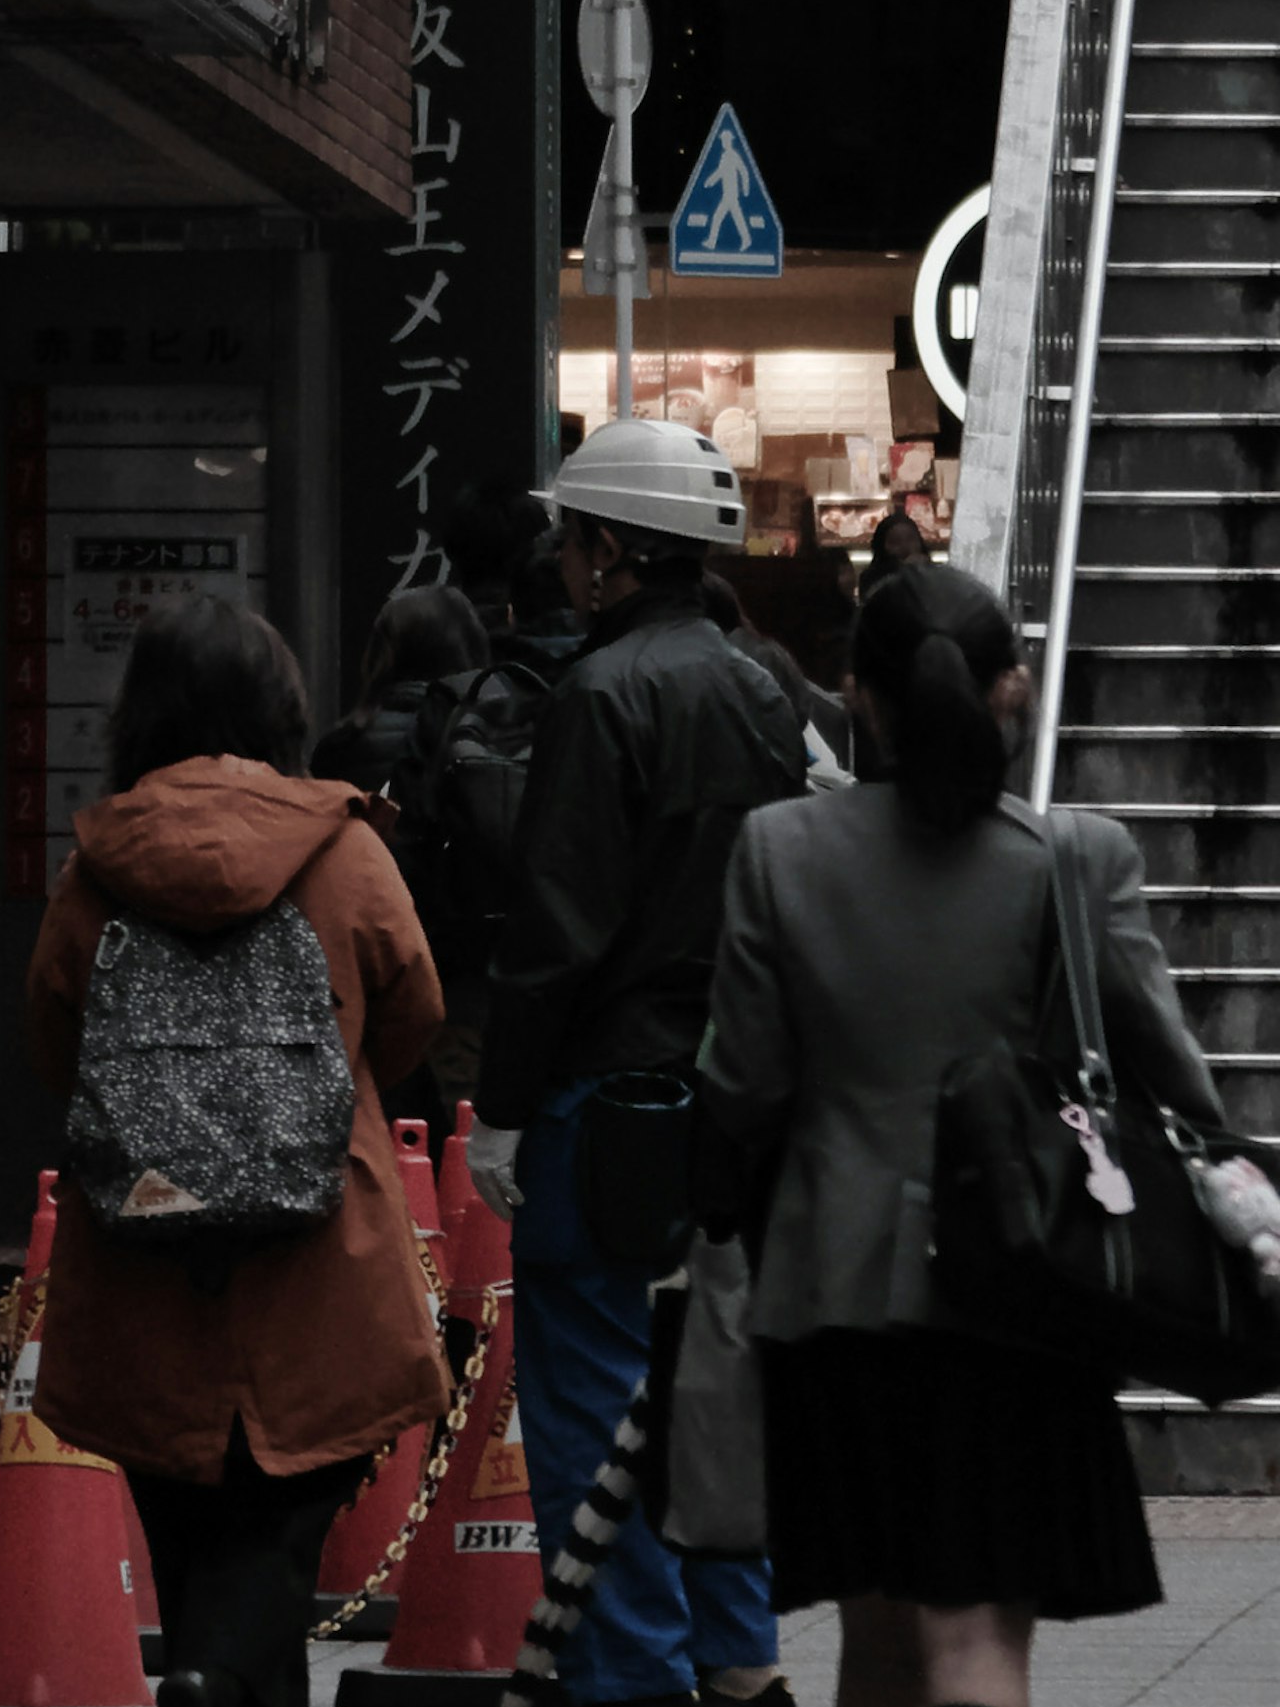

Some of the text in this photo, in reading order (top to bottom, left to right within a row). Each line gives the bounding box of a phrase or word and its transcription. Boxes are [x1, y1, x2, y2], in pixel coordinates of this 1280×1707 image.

[17, 460, 33, 494] 7
[17, 533, 33, 559] 6
[17, 593, 33, 623] 5
[17, 659, 33, 689] 4
[17, 724, 33, 754] 3
[17, 789, 33, 820] 2
[17, 852, 33, 885] 1
